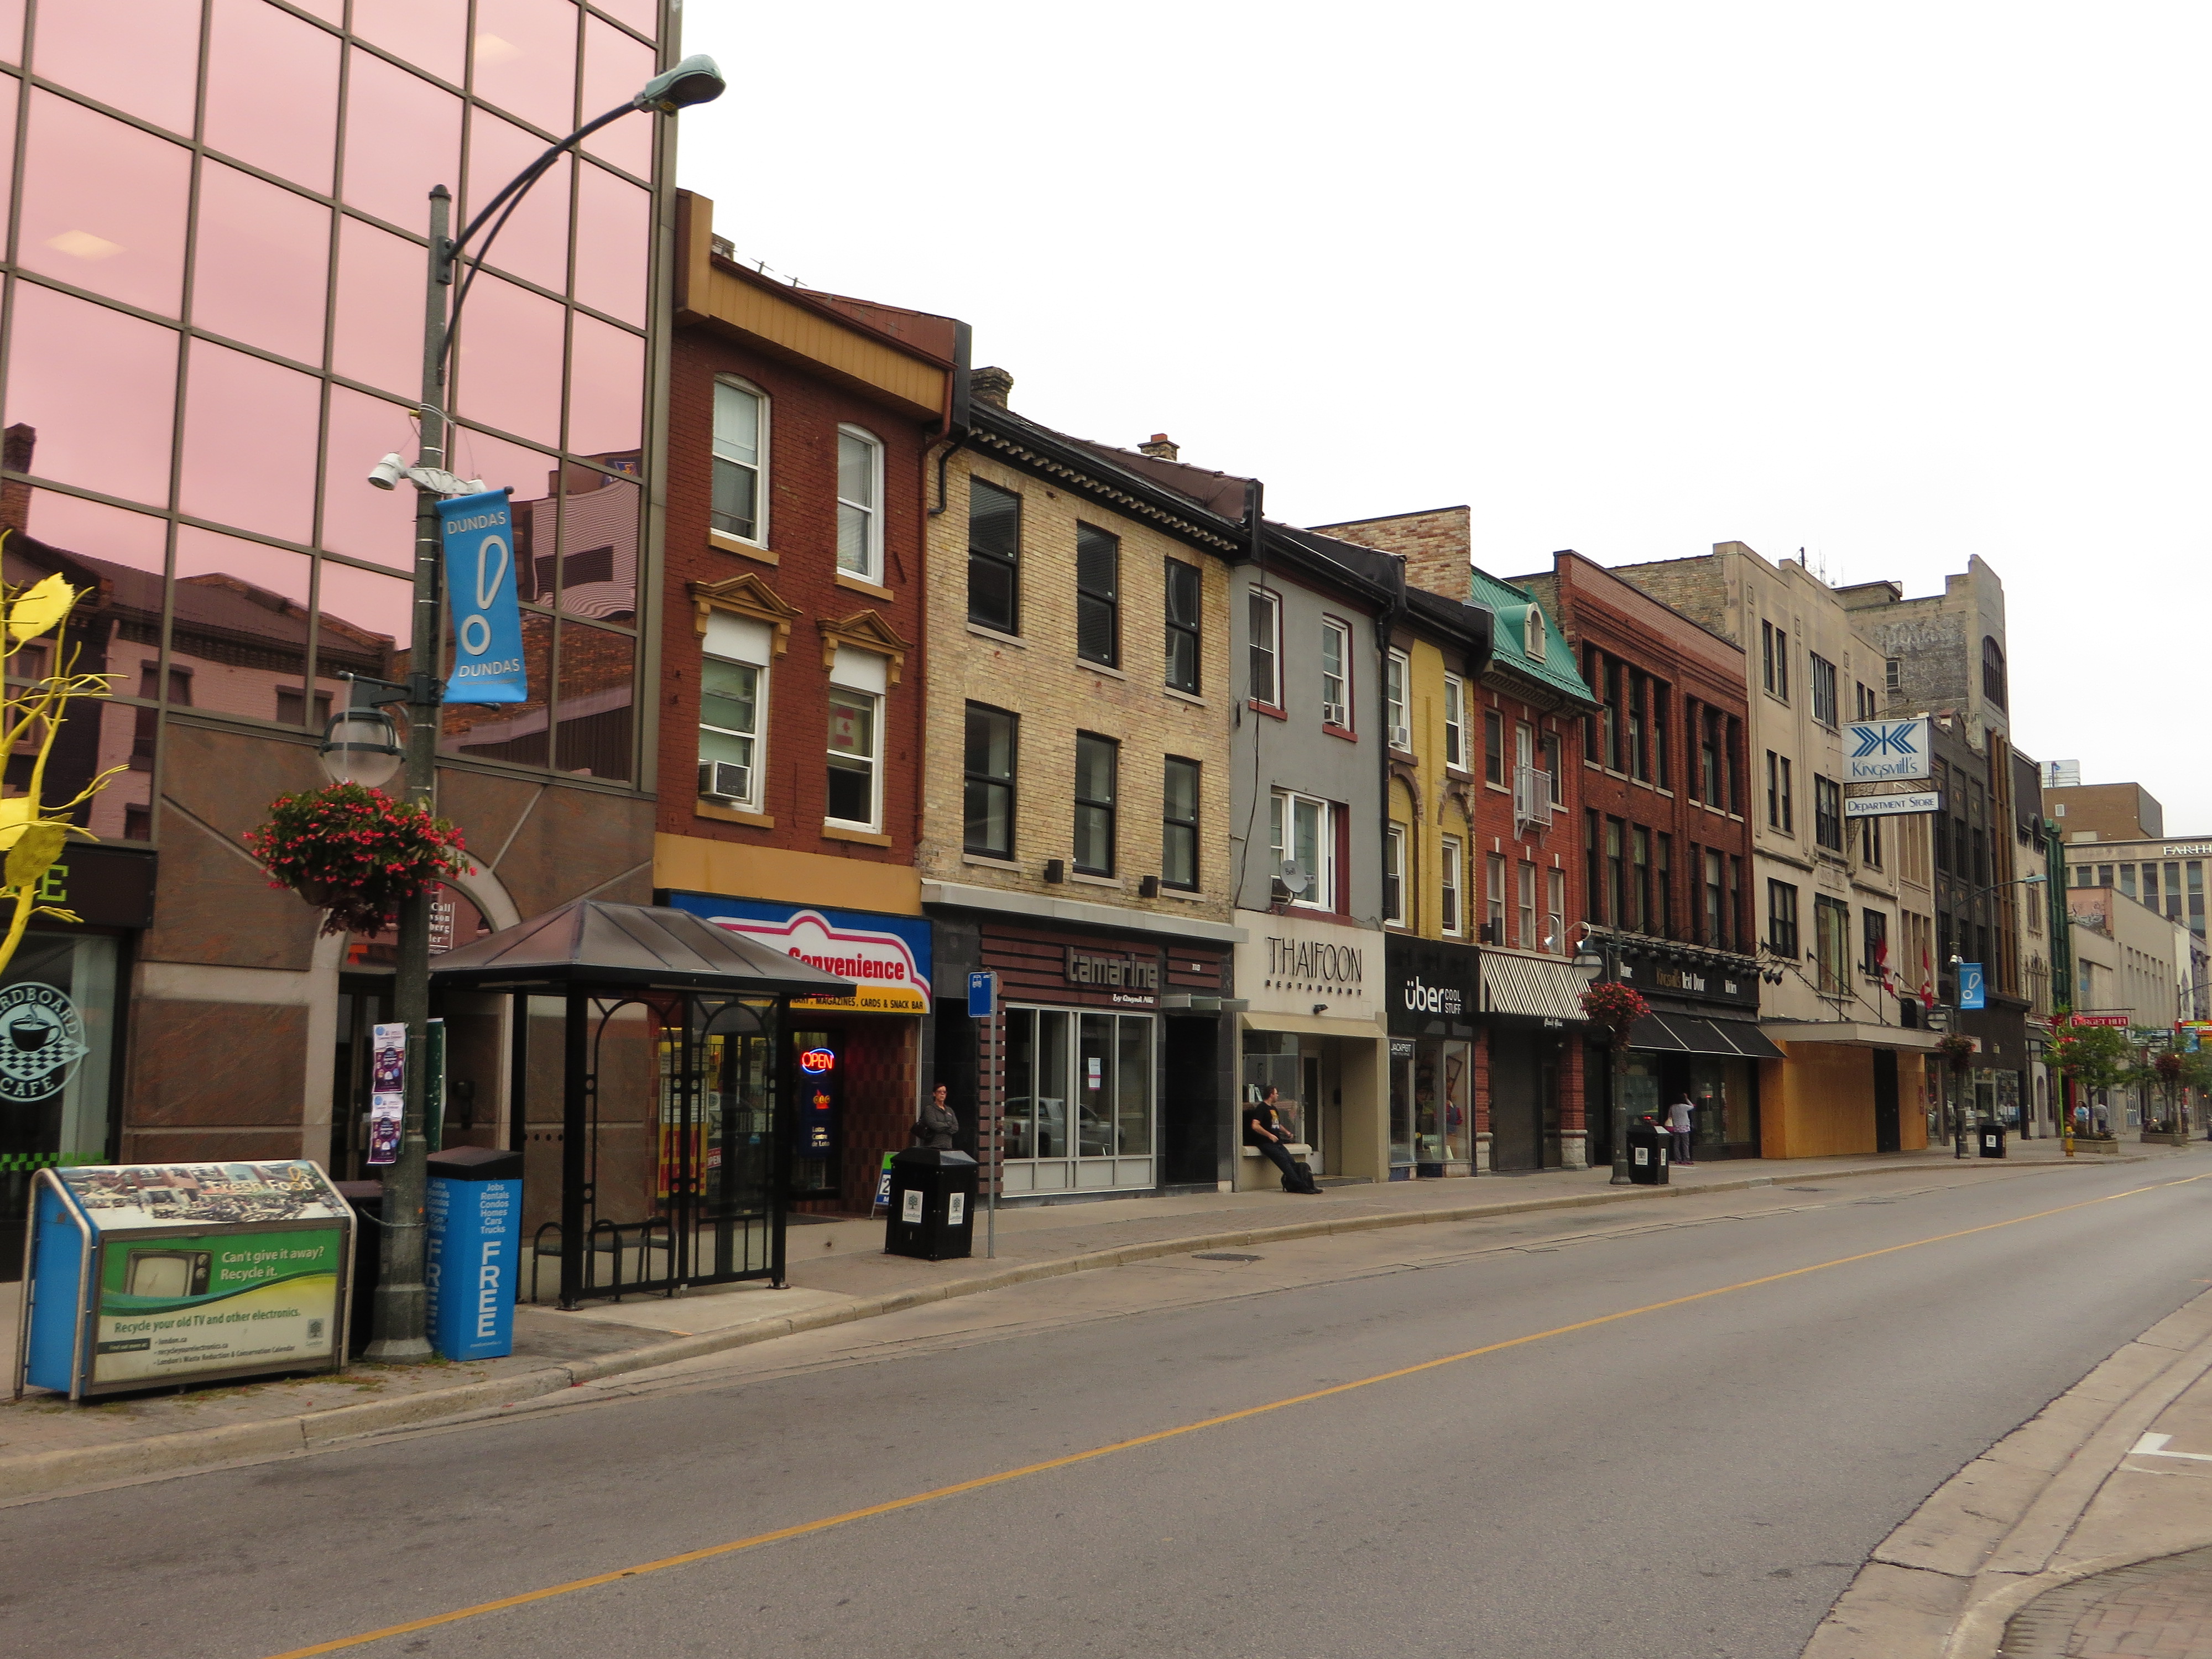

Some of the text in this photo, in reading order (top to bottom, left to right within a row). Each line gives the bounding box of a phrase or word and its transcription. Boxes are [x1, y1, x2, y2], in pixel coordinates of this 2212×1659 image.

[447, 512, 507, 535] DUNDAS
[458, 658, 520, 677] DUNDAS
[1853, 757, 1918, 778] Kingsmill's
[1066, 946, 1159, 988] tamarine
[1267, 936, 1362, 983] THAIFOON
[1265, 979, 1362, 996] RESTAURANT
[1405, 975, 1444, 1013] über
[1444, 988, 1462, 1002] COOL
[860, 998, 881, 1008] CARDS
[883, 999, 888, 1008] &
[890, 1000, 909, 1009] SNACK
[911, 1001, 924, 1010] BAR
[1444, 1003, 1462, 1014] STUFF
[801, 1052, 834, 1070] OPEN
[265, 1174, 315, 1191] Food
[480, 1199, 509, 1208] Condos
[481, 1191, 510, 1200] Rentals
[481, 1225, 506, 1234] Trucks
[222, 1246, 324, 1264] Can't give it away?
[221, 1266, 278, 1282] Recycle it.
[477, 1241, 501, 1337] FREE
[114, 1307, 300, 1334] Recycle your old TV and other electronics.
